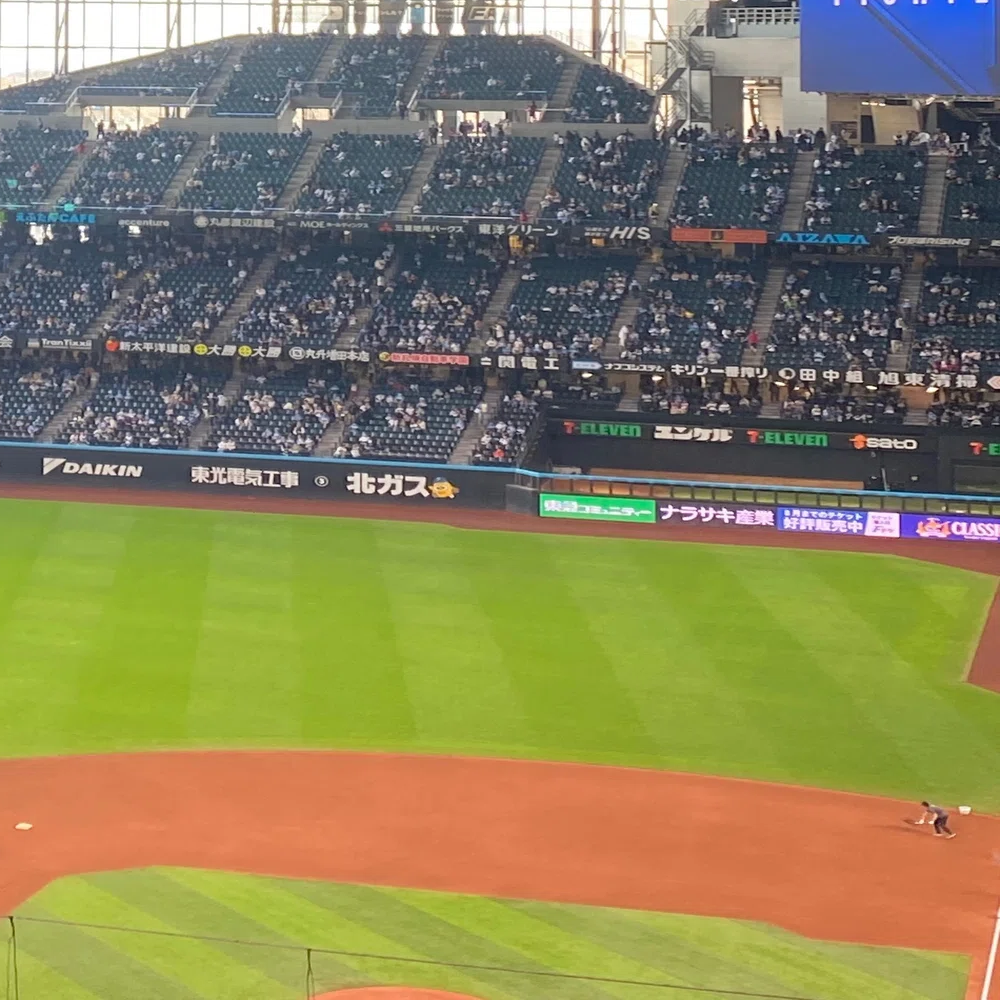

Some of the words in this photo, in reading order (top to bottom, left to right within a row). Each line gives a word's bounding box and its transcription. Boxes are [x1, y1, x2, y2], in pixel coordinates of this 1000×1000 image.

[118, 219, 170, 227] accenture
[478, 223, 559, 237] 東洋グリーン
[609, 226, 651, 240] HIS
[671, 364, 768, 379] キリン一番搾り
[800, 368, 864, 384] 田中組
[653, 425, 734, 442] ユンケル
[62, 462, 144, 478] DAIKIN
[191, 466, 300, 488] 東光電気工事
[346, 472, 430, 498] 北ガス
[660, 505, 775, 526] ナラサキ産業
[784, 517, 864, 534] 好評販売中
